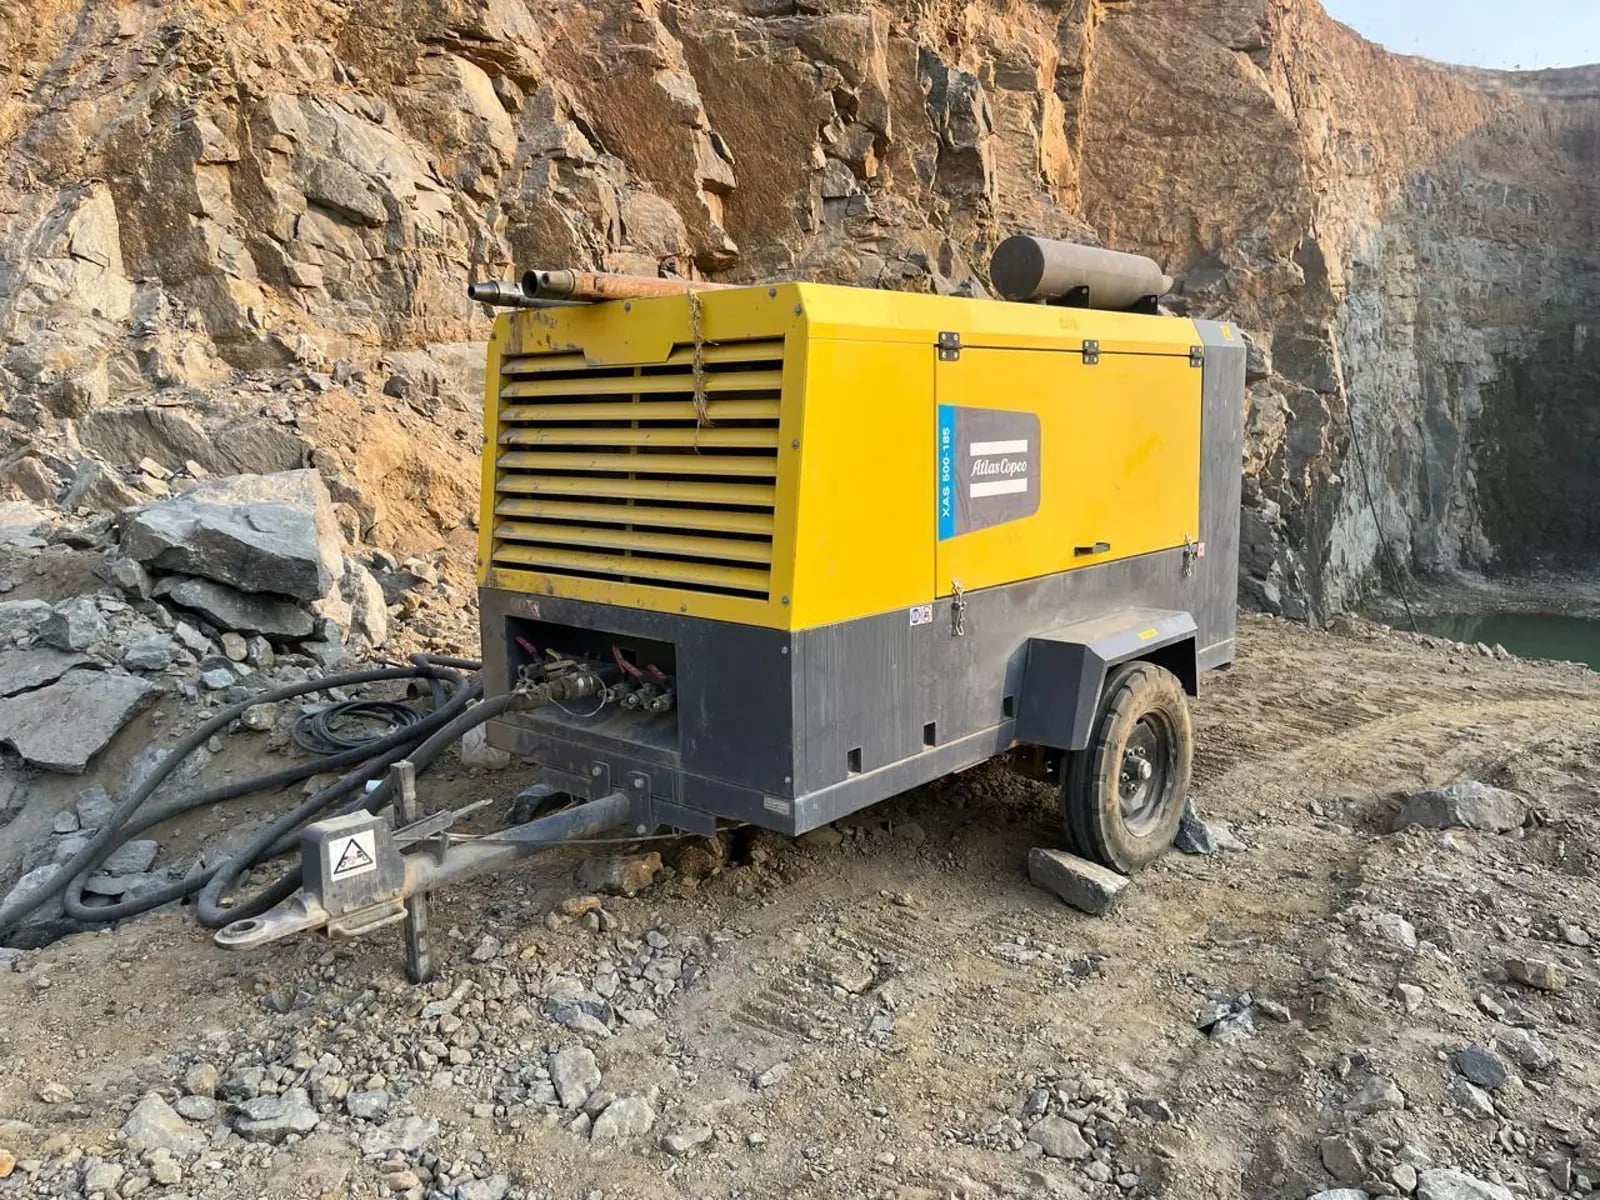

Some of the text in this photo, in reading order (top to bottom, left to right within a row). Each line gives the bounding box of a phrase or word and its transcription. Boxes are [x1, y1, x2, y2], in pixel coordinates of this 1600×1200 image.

[942, 427, 950, 517] XAS 500-185
[971, 458, 1027, 477] Atlas Copco
